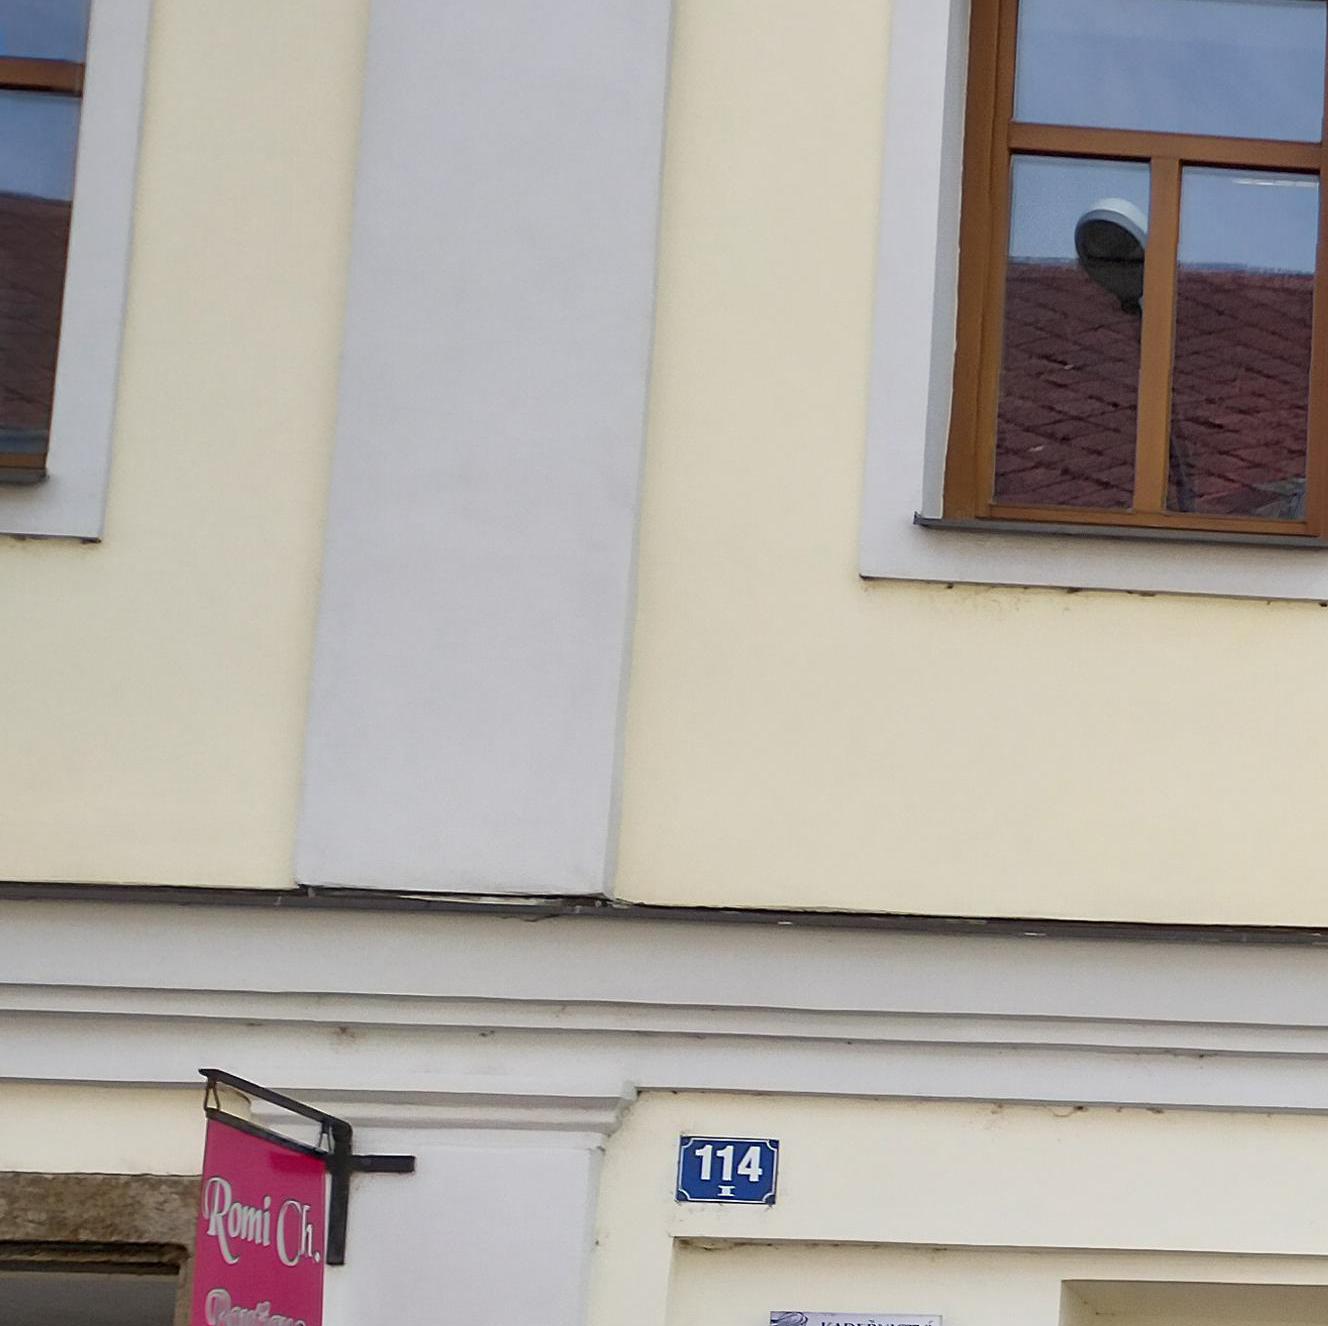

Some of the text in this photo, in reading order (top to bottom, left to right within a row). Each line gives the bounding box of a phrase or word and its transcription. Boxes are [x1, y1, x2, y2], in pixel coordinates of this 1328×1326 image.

[695, 1144, 763, 1182] 114
[203, 1176, 321, 1266] Romi Ch.
